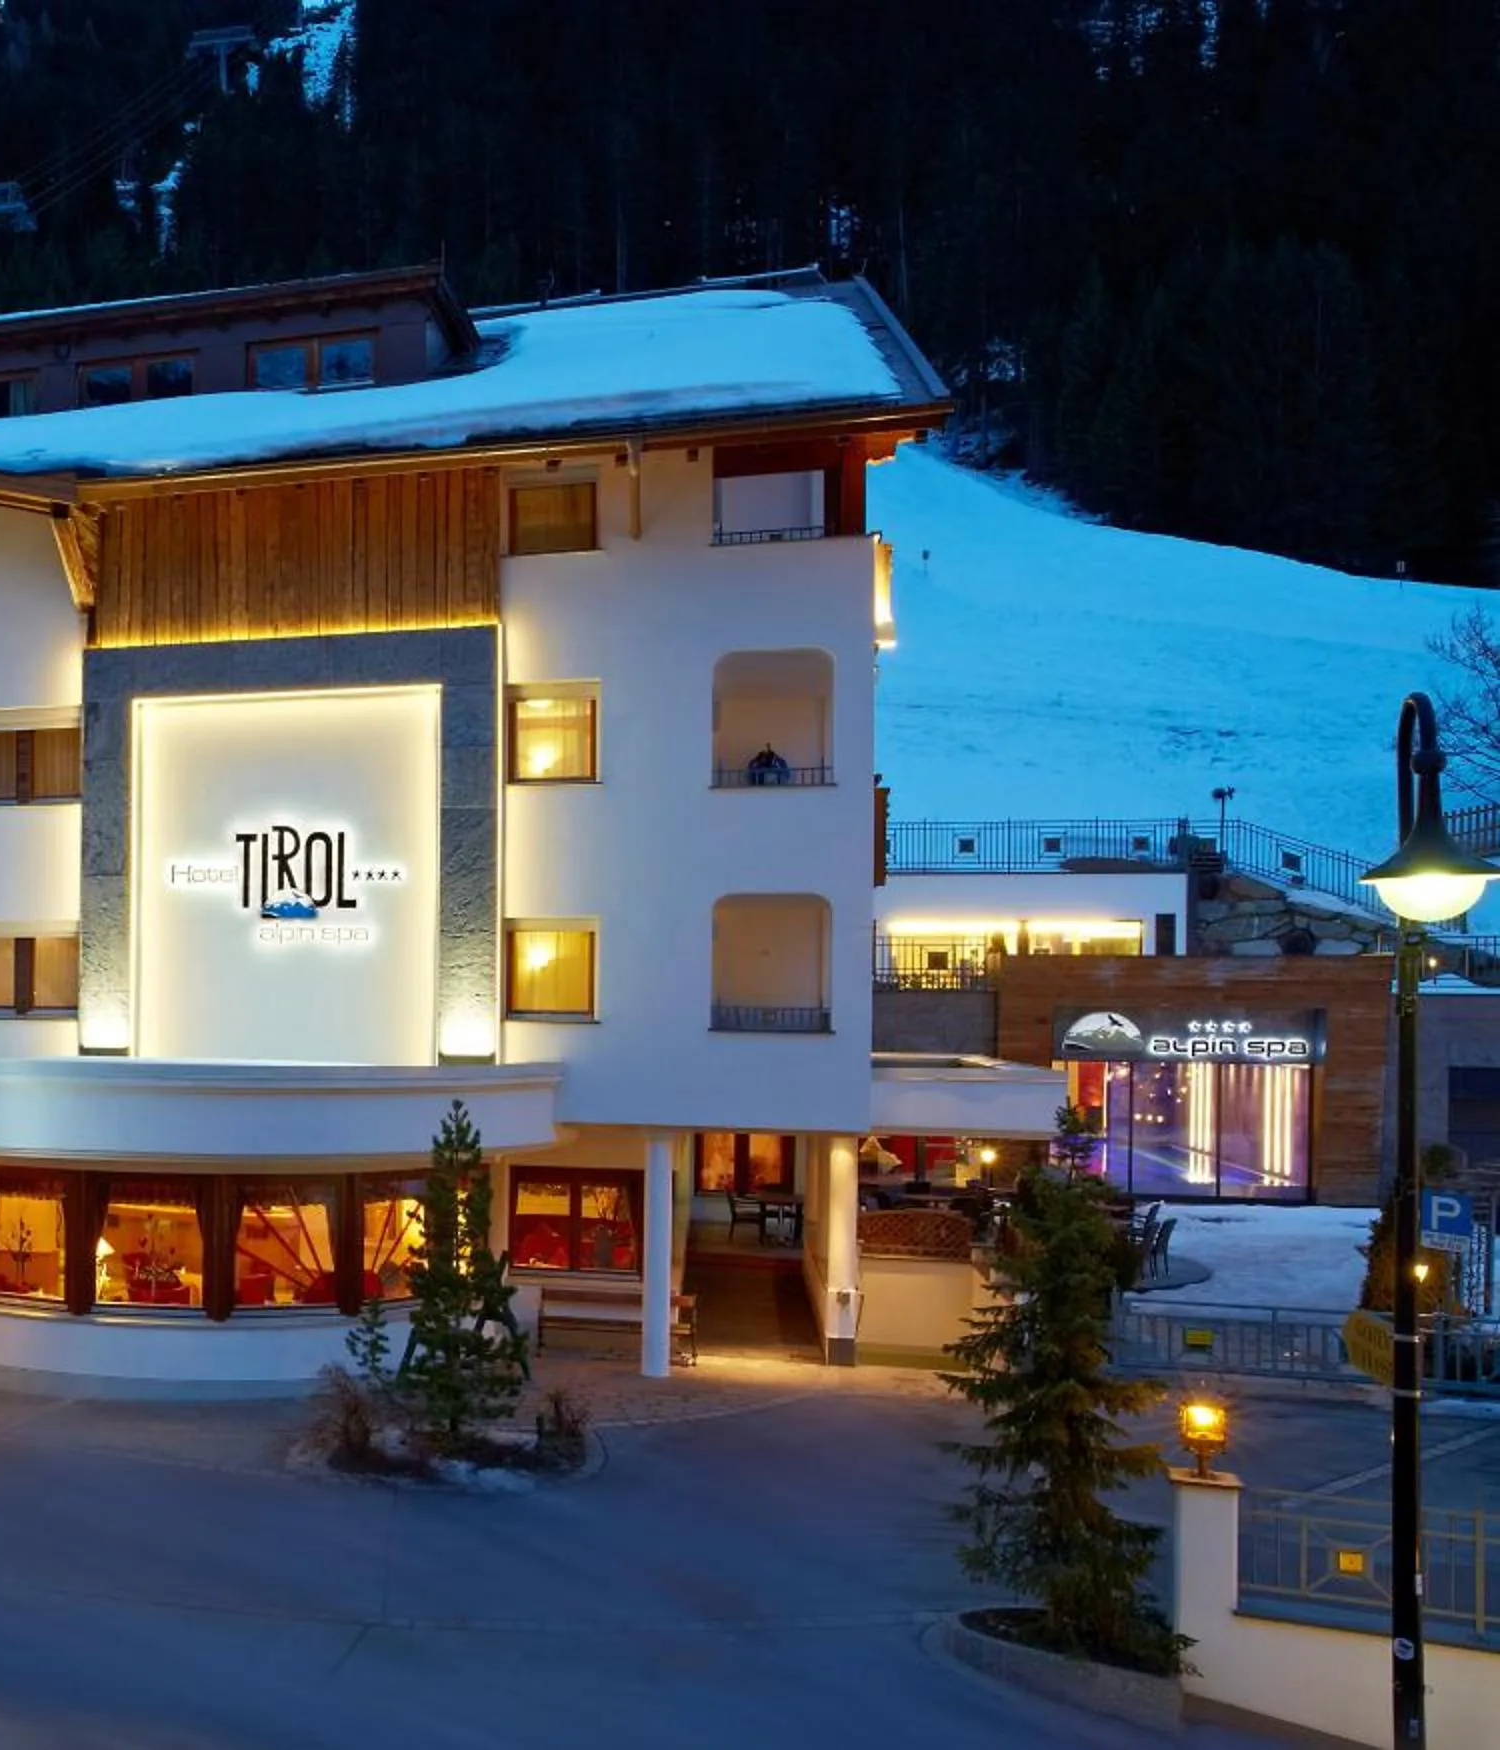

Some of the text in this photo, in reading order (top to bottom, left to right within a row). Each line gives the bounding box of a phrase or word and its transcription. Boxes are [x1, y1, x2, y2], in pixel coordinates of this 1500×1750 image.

[170, 825, 357, 909] Hotel TIROL
[259, 923, 369, 944] alpin spa
[1151, 1036, 1309, 1059] alpin spa
[1430, 1195, 1461, 1230] P
